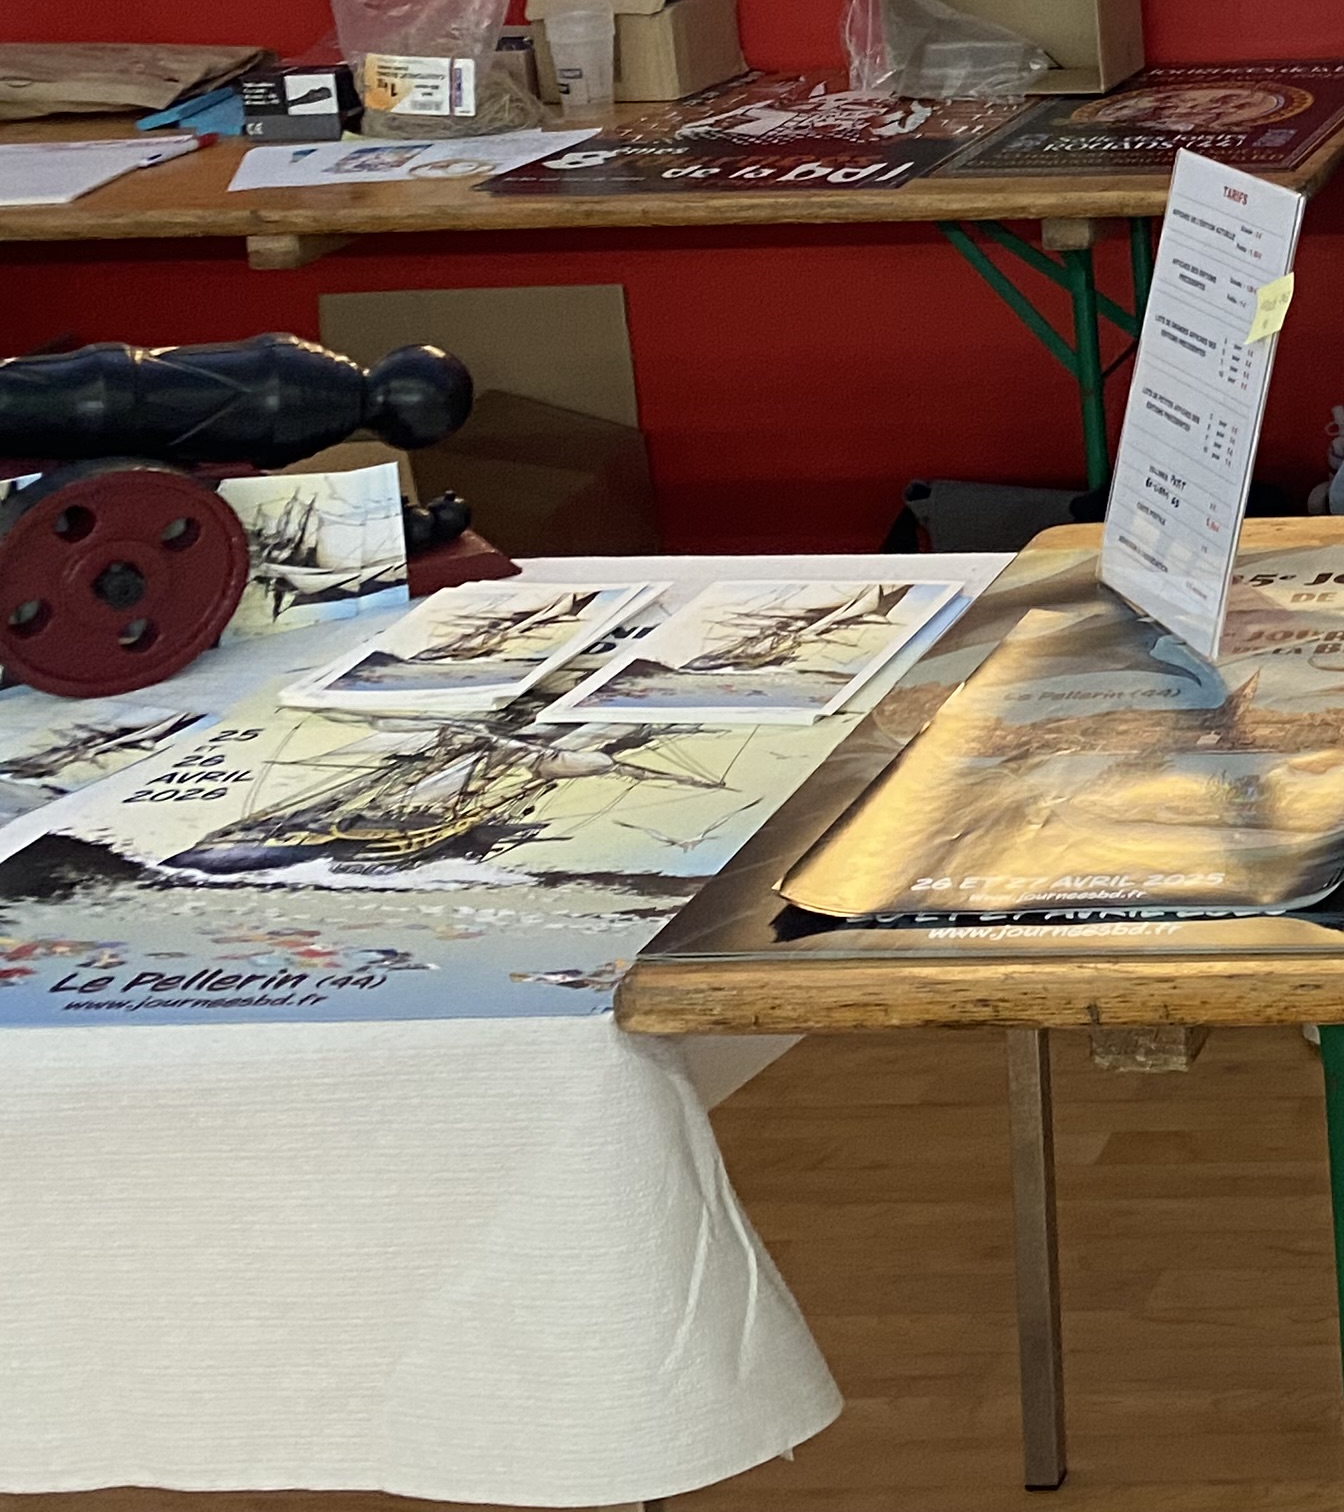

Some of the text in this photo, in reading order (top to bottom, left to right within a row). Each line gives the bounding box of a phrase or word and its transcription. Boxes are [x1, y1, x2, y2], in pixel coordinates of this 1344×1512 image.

[1290, 591, 1335, 604] DE
[1038, 690, 1124, 702] Pellerin
[210, 727, 266, 742] 25
[172, 755, 226, 768] 26
[148, 768, 258, 785] AVRIL
[123, 786, 229, 805] 2026
[911, 872, 1226, 891] 26 ET AVRIL 2025
[969, 889, 1149, 904] www.journeesbd.fr
[927, 922, 1183, 941] www.journeesbd.fr
[50, 968, 389, 994] Le Pellerin (44)
[62, 993, 329, 1014] www.journeesbd.fr
